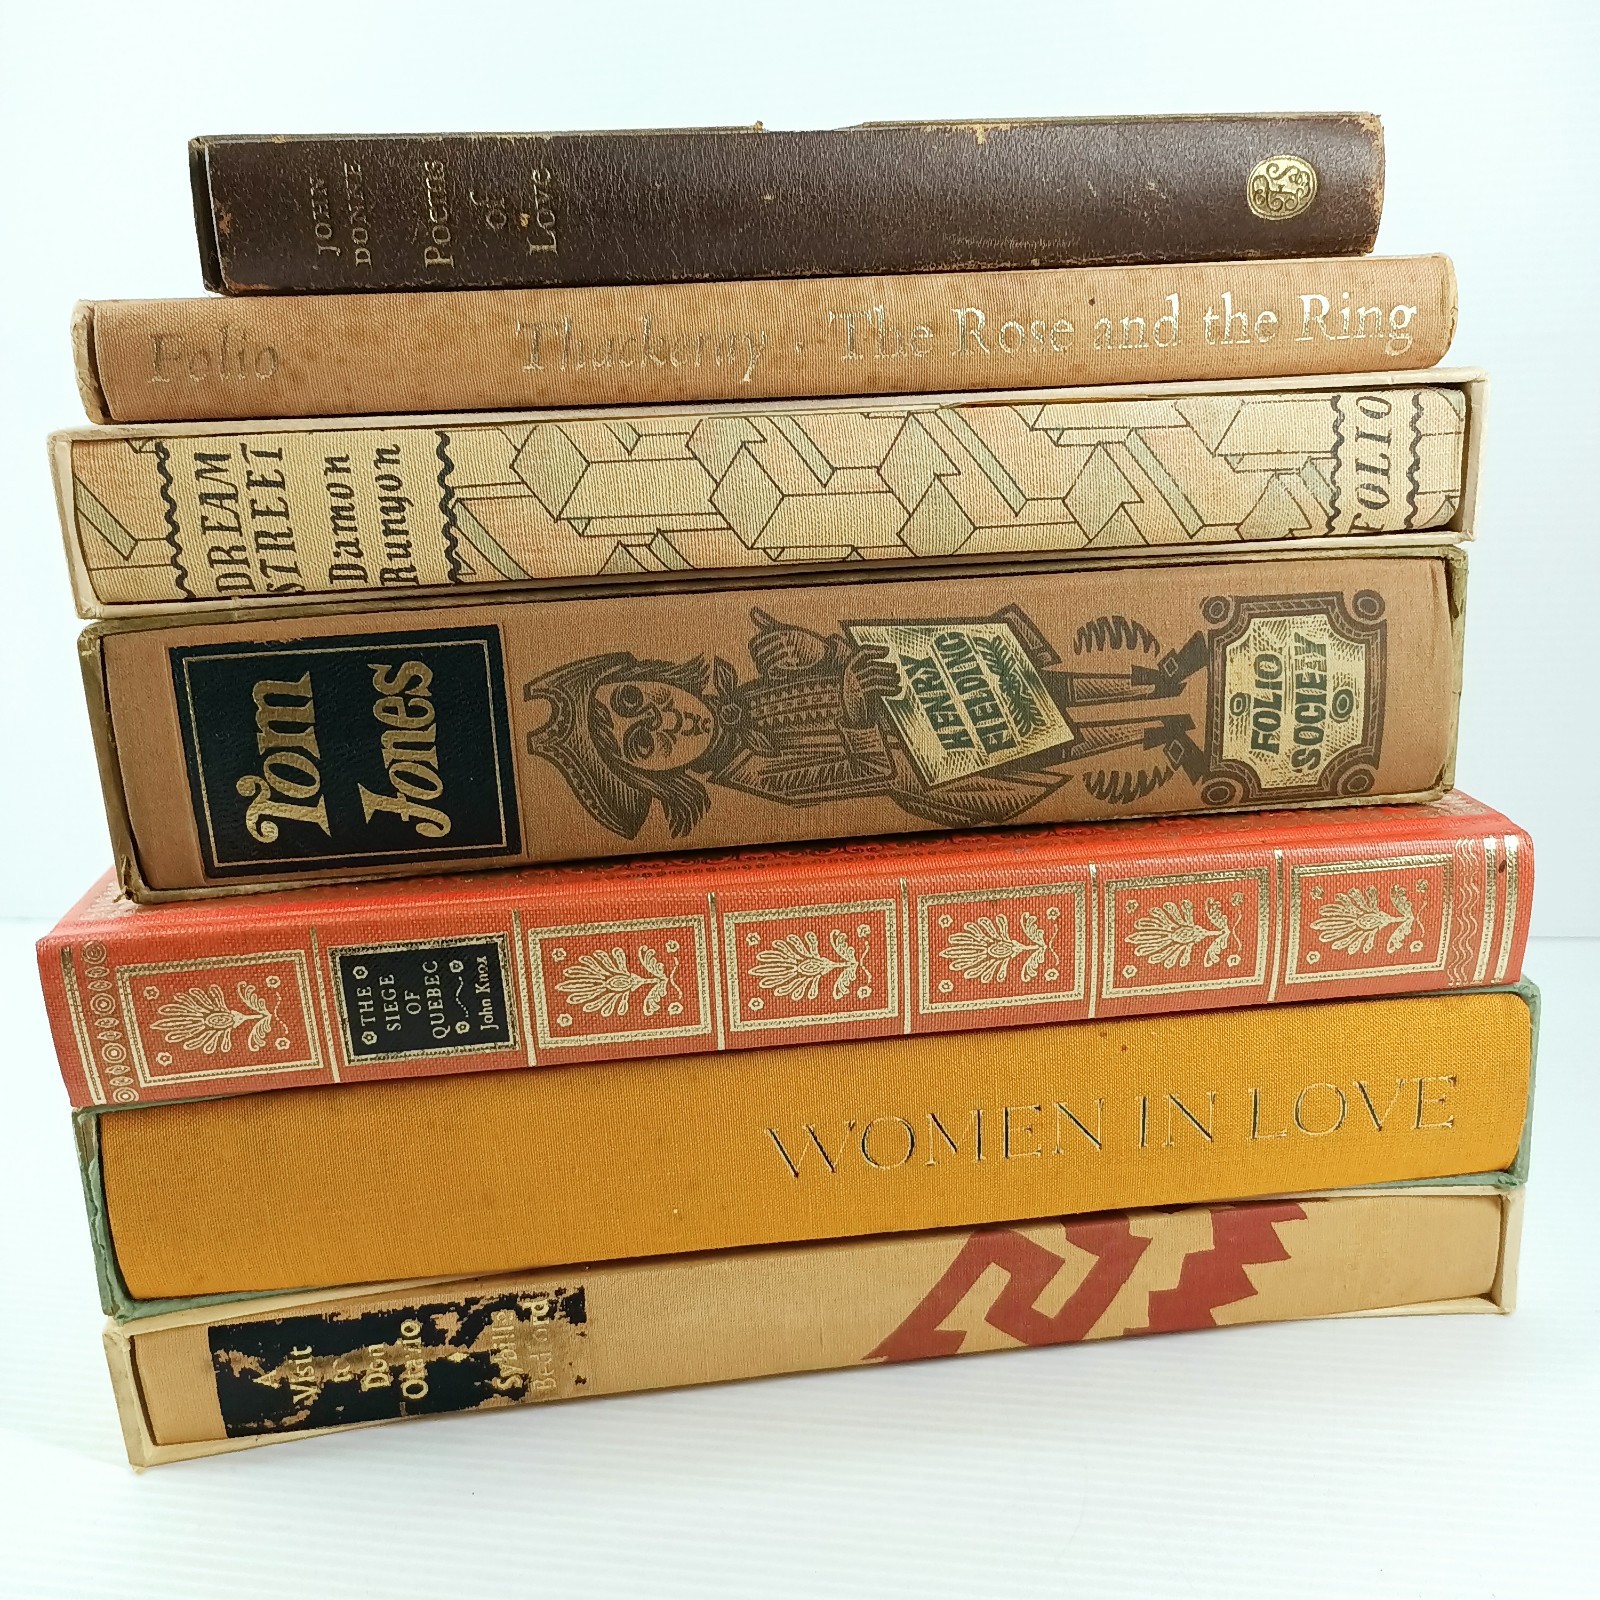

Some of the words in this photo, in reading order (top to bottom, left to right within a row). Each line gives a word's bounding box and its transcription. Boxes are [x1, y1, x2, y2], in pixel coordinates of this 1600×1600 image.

[148, 324, 279, 383] Folio
[829, 304, 934, 361] The
[951, 307, 1076, 357] Rose
[1093, 293, 1180, 350] and
[1203, 291, 1278, 345] the
[1295, 291, 1418, 357] Ring
[194, 452, 256, 593] DREAM
[240, 443, 304, 593] STREET
[324, 454, 369, 585] Damon
[373, 444, 420, 587] Runyon
[898, 654, 976, 751] HENRY
[934, 631, 1020, 755] FIELDING
[1250, 653, 1283, 755] FOLIO
[1291, 631, 1328, 773] SOCIETY
[236, 671, 332, 843] Tom
[358, 660, 451, 838] Jones
[356, 986, 376, 1027] THE
[379, 974, 402, 1032] SIEGE
[404, 989, 422, 1015] OF
[422, 960, 451, 1039] QUEBEC
[474, 955, 491, 994] Knox
[476, 997, 500, 1031] John
[764, 1098, 1104, 1179] WOMEN
[1138, 1091, 1217, 1149] IN
[1250, 1075, 1458, 1141] LOVE
[252, 1369, 281, 1389] A
[290, 1345, 320, 1404] Visit
[361, 1342, 391, 1392] Don
